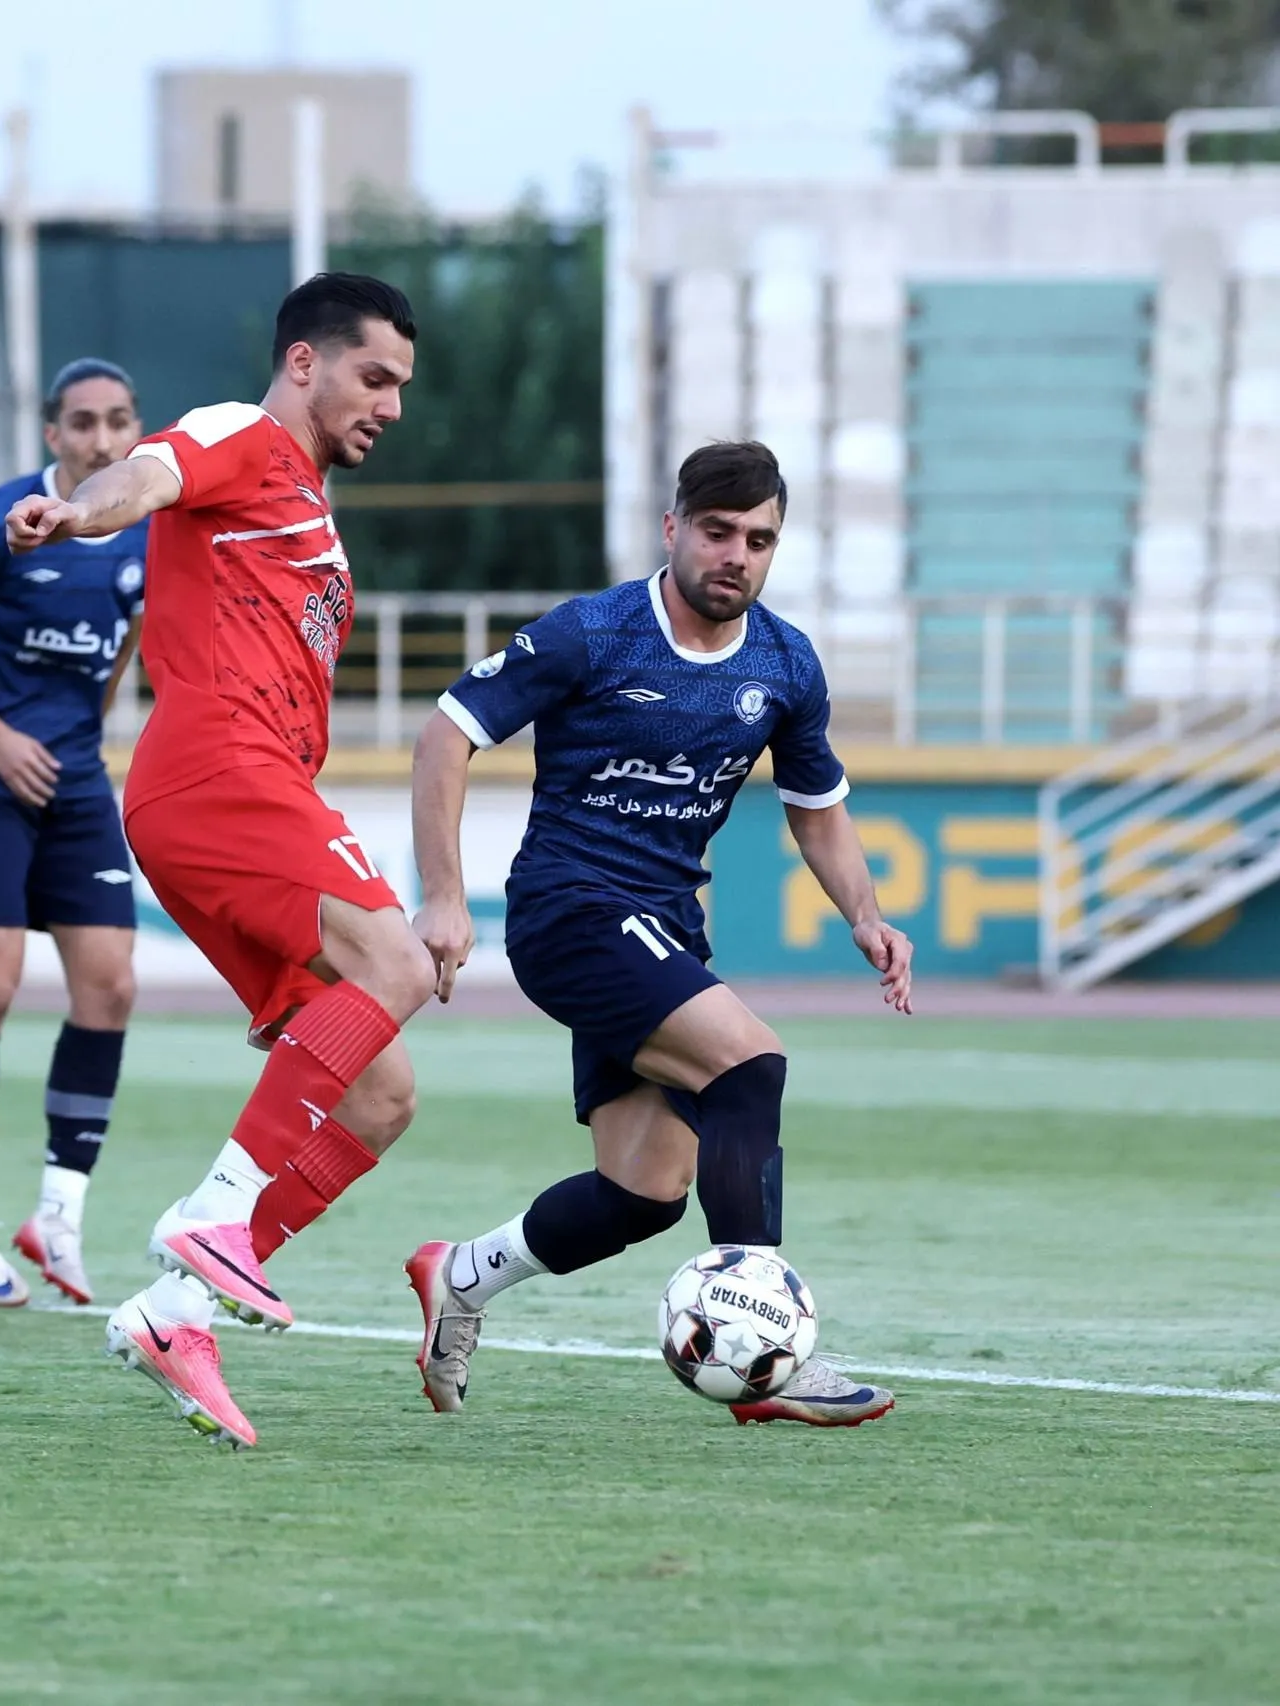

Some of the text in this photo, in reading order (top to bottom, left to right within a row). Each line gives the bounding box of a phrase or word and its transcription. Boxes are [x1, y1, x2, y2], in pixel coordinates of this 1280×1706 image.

[590, 752, 749, 794] گل گهر
[581, 792, 617, 807] کویر
[617, 798, 642, 814] دل
[642, 804, 662, 818] در
[327, 834, 380, 881] 17
[709, 1285, 791, 1330] DERBYSTAR
